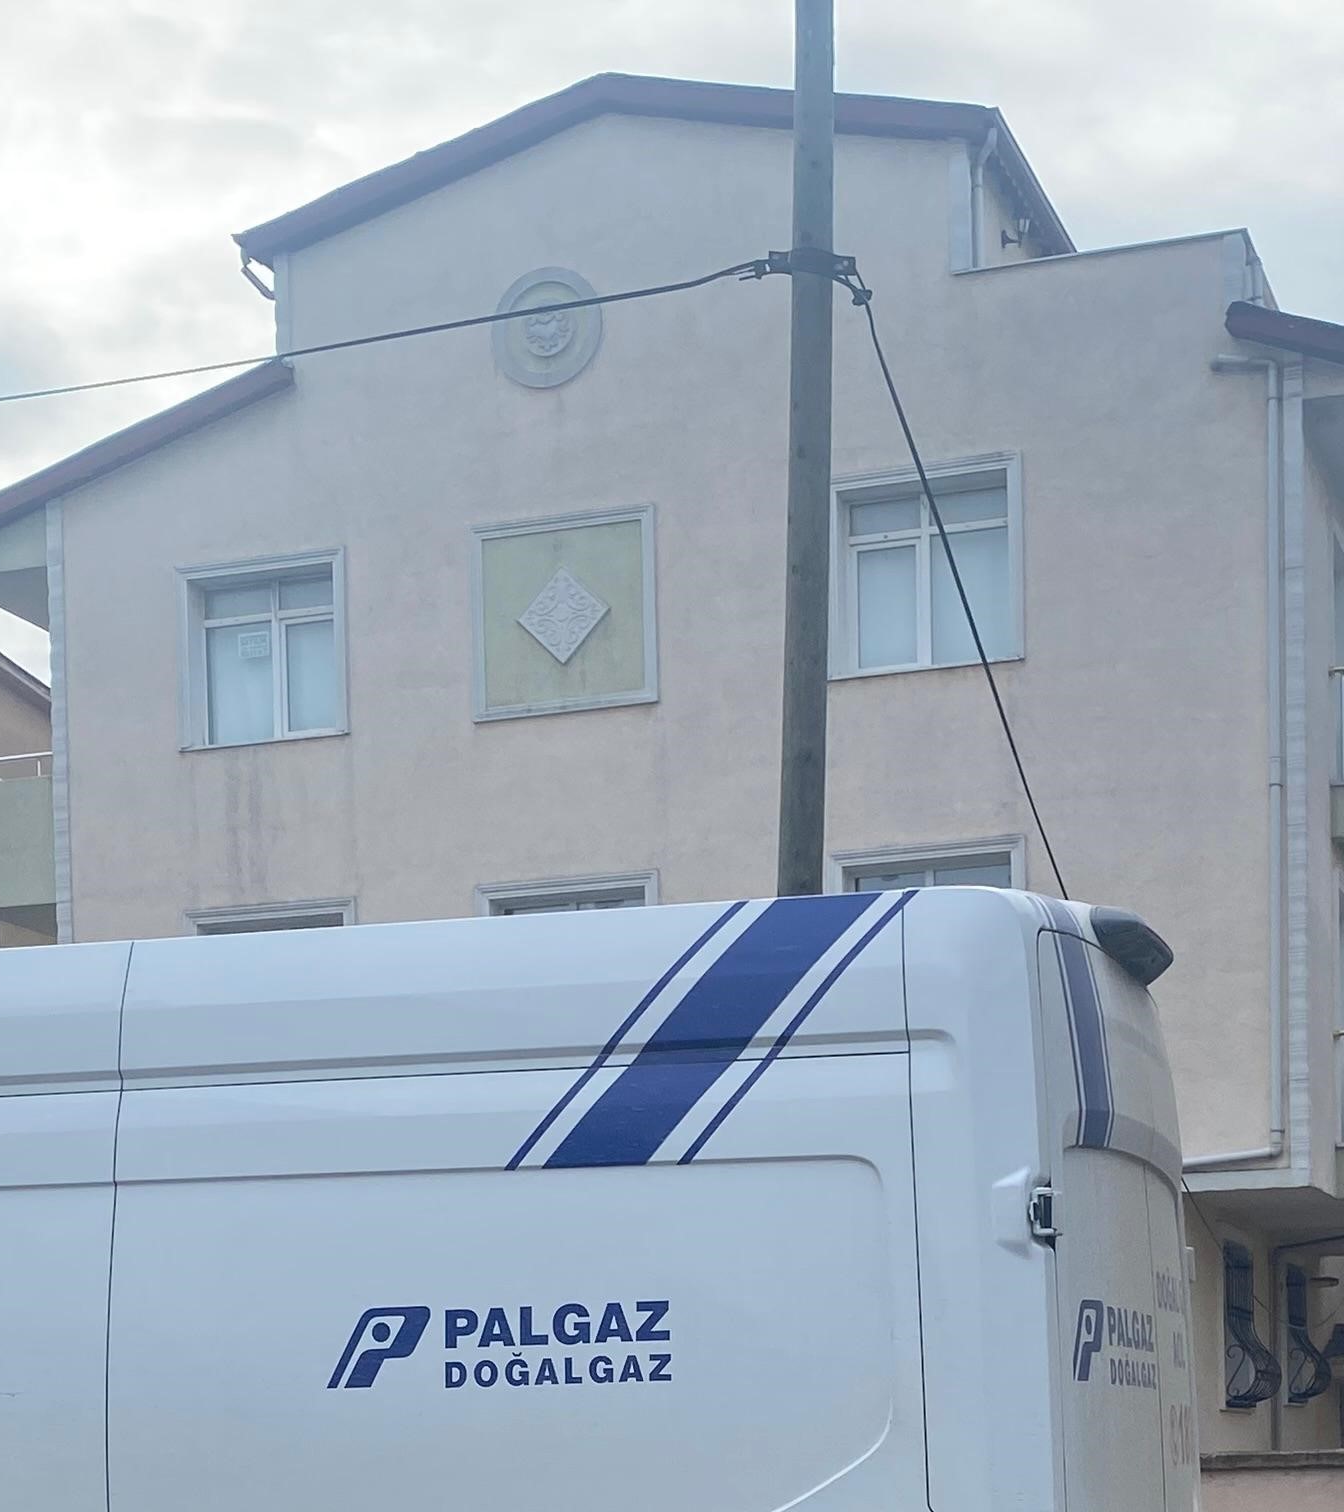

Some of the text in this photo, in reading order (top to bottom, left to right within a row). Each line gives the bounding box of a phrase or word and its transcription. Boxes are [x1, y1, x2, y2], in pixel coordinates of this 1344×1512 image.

[444, 1300, 671, 1349] PALGAZ
[1106, 1306, 1154, 1352] PALGAZ
[444, 1351, 672, 1389] DOĞALGAZ
[1109, 1353, 1157, 1390] DOĞALGAZ
